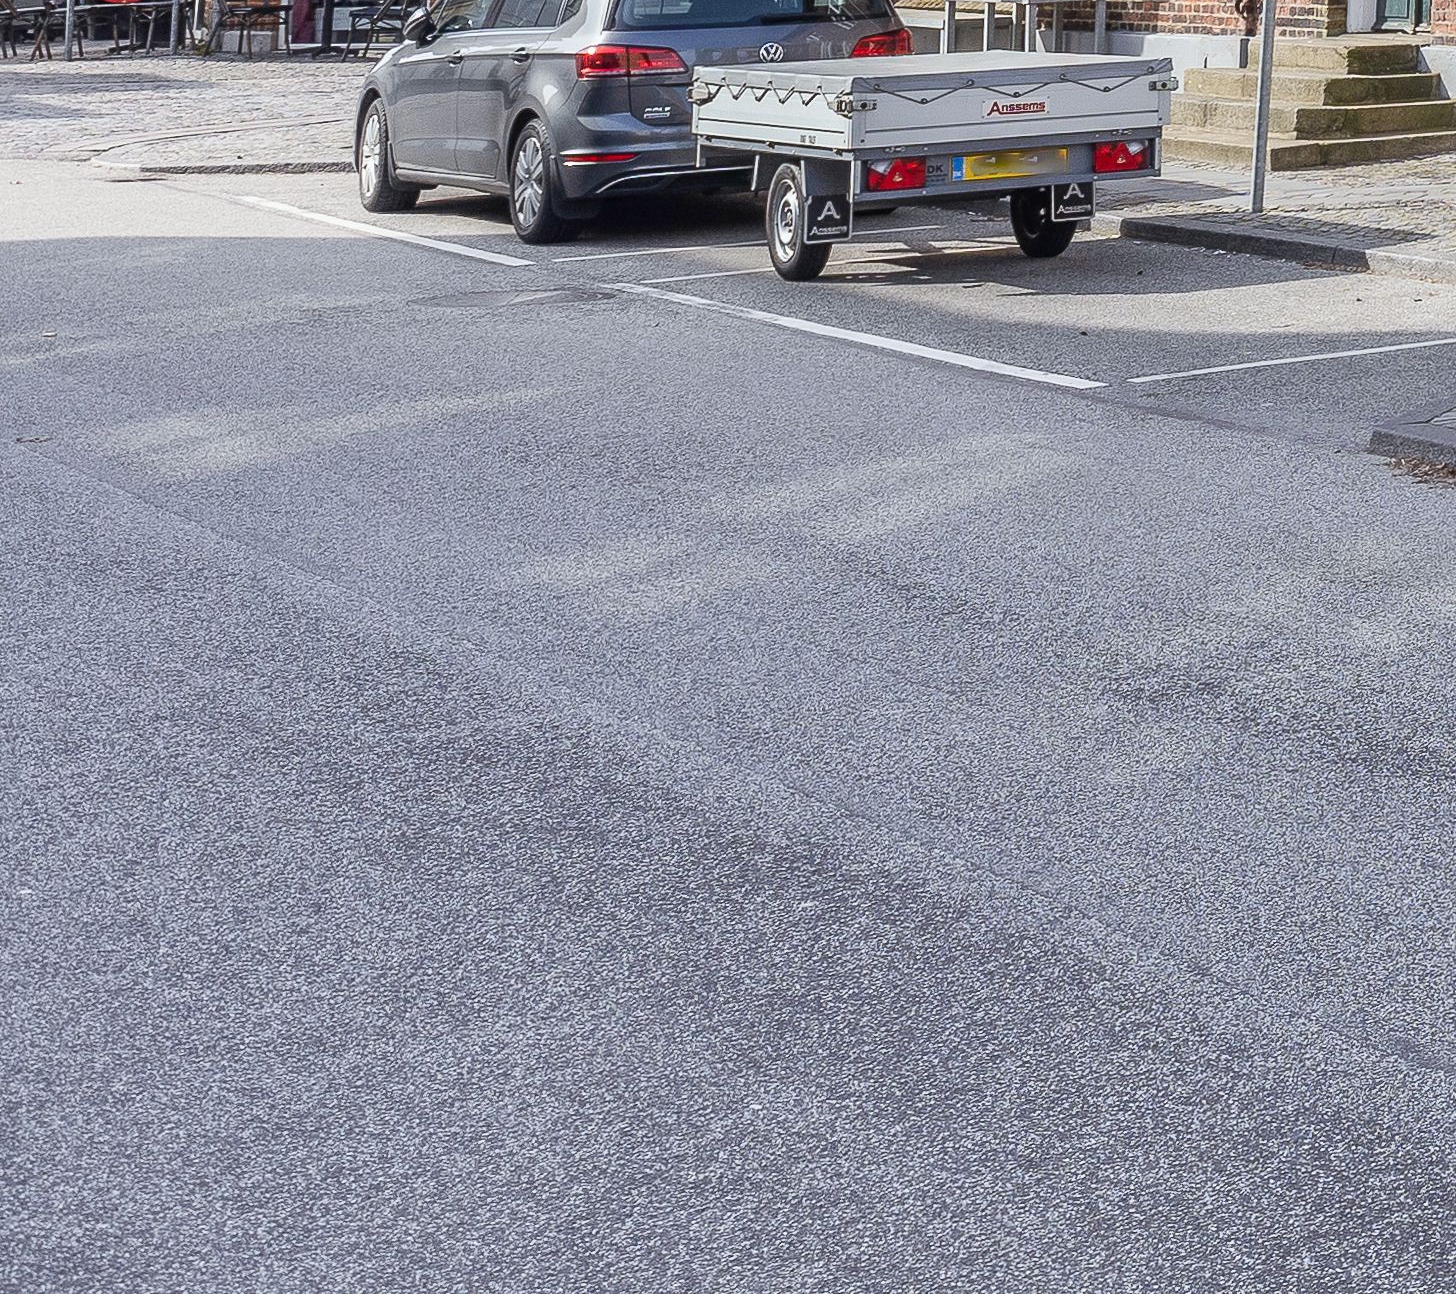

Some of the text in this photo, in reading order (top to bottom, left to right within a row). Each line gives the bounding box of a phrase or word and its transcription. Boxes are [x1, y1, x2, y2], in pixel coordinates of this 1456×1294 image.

[987, 101, 1046, 116] Anssems
[927, 164, 944, 174] DK
[817, 201, 840, 221] A
